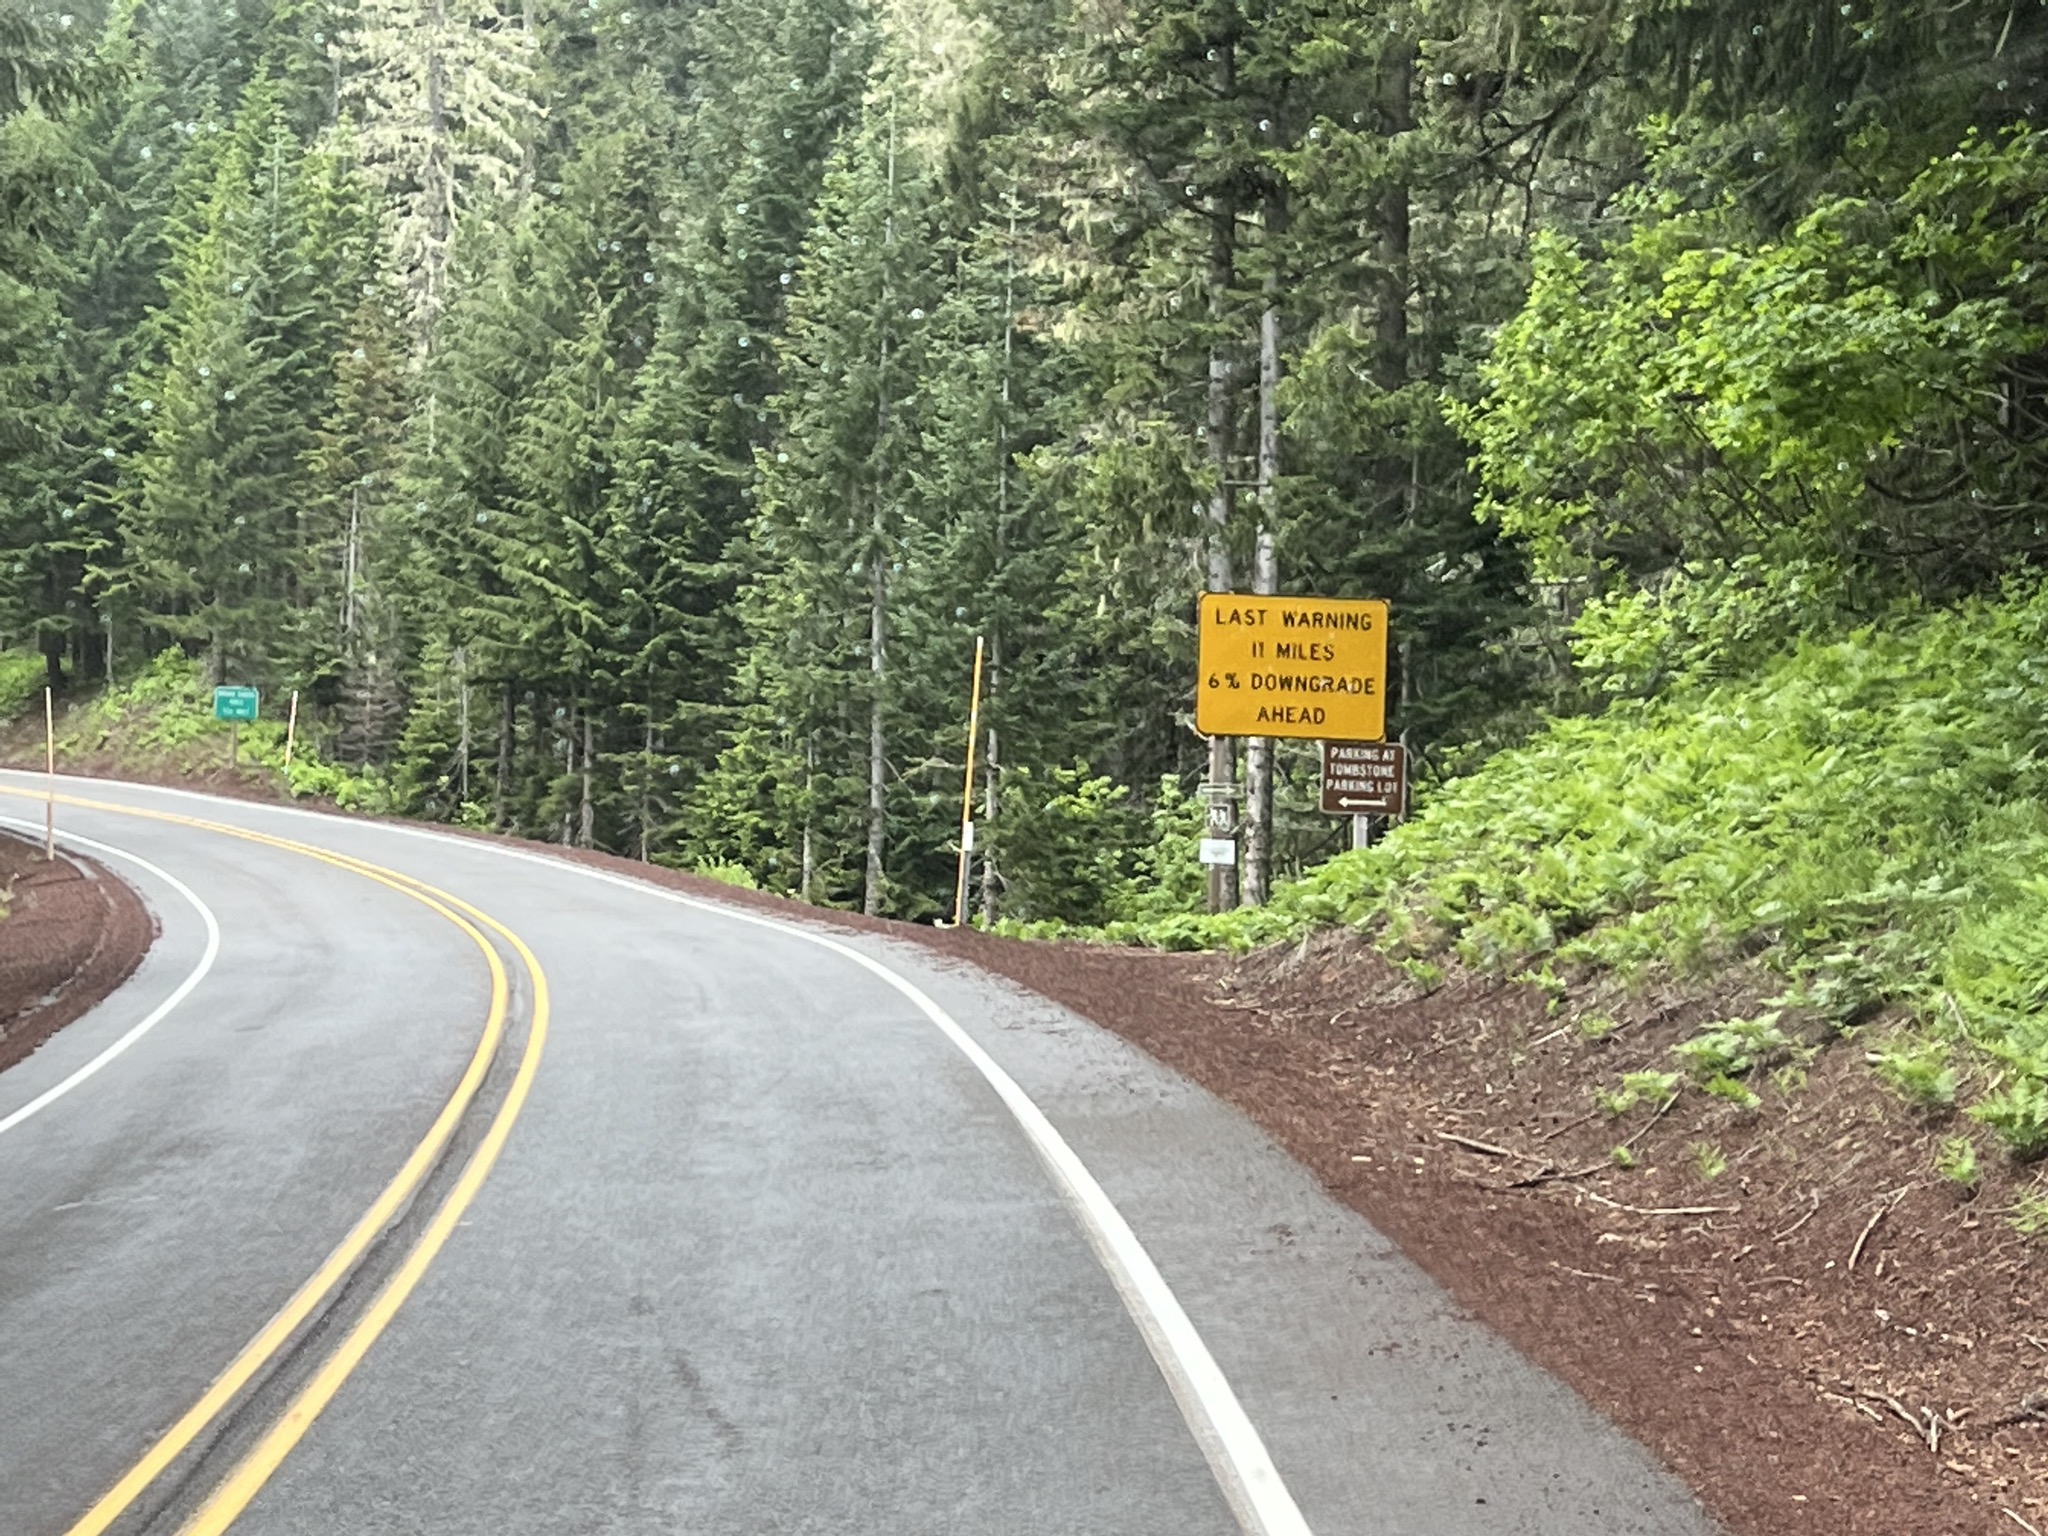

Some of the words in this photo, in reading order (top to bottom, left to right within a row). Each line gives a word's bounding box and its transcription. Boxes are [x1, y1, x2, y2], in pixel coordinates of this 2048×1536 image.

[1215, 607, 1268, 627] LAST
[1282, 610, 1373, 632] WARNING
[1252, 641, 1265, 659] 11
[1276, 642, 1335, 662] MILES
[1251, 672, 1376, 696] DOWNGRADE
[1256, 705, 1326, 725] AHEAD
[1330, 746, 1380, 762] PARKING
[1382, 749, 1396, 762] AT
[1329, 762, 1396, 778] TOMBSTONE
[1326, 778, 1375, 793] PARKING
[1376, 781, 1399, 794] LOT
